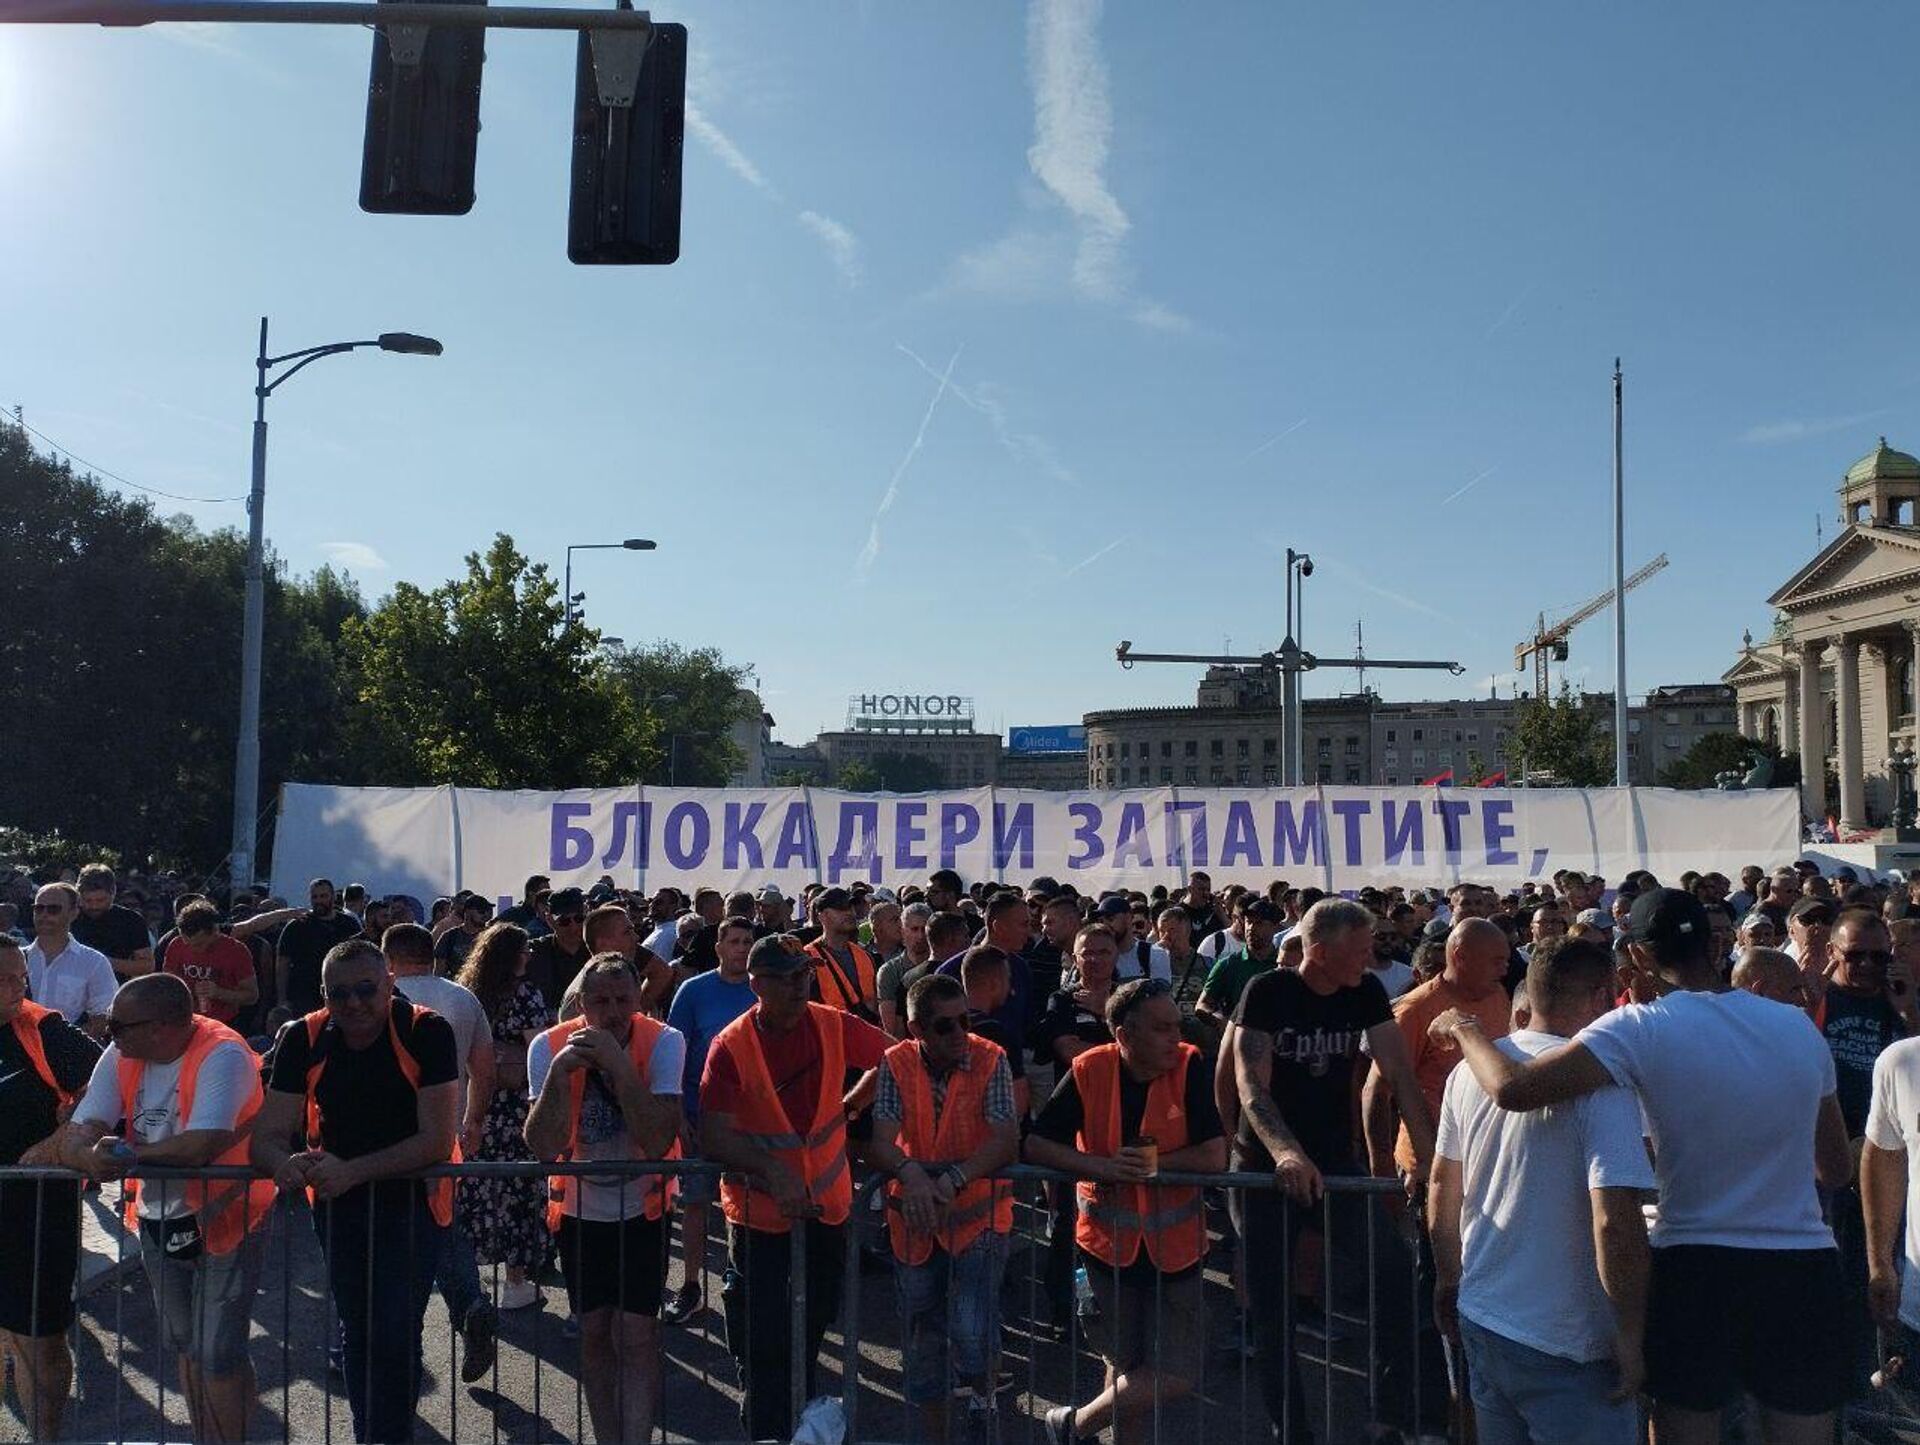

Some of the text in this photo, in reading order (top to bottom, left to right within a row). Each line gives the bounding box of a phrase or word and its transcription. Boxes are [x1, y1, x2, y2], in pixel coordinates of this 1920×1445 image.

[861, 694, 962, 715] HONOR
[549, 799, 1550, 884] БЛОКАДЕРИ ЗАПАМТИТЕ,
